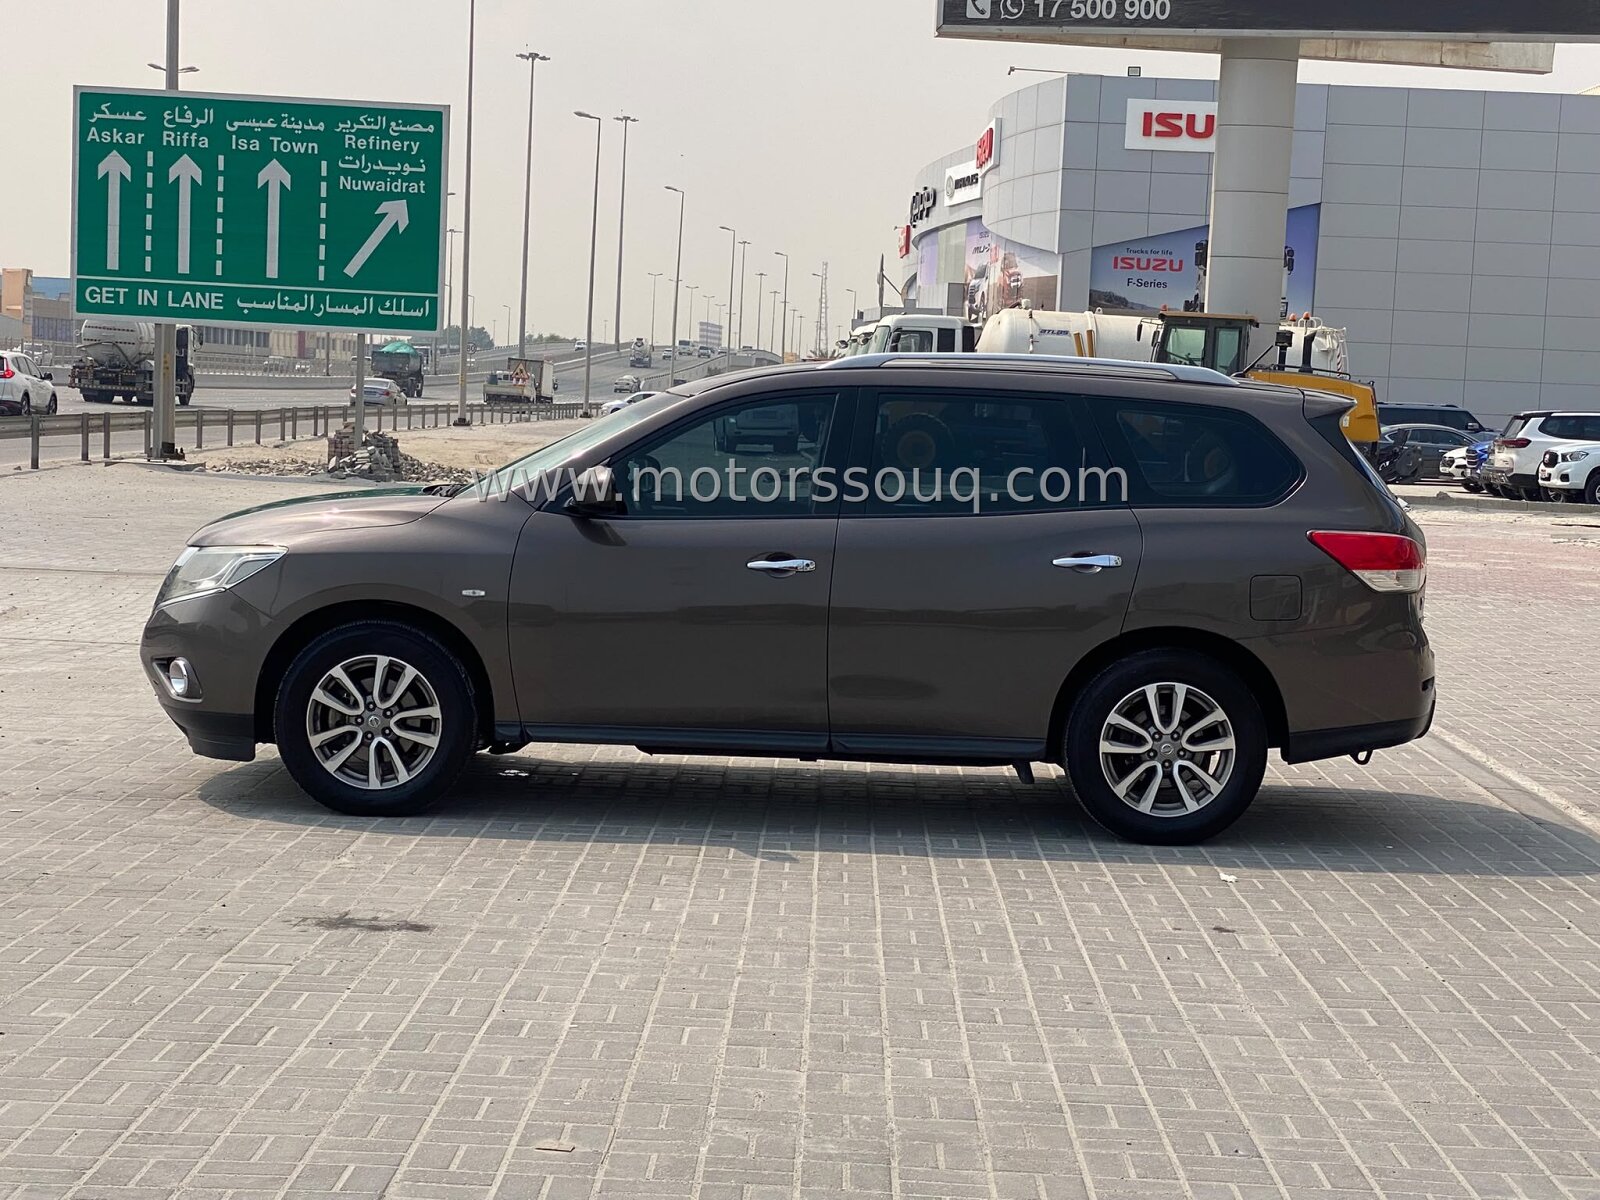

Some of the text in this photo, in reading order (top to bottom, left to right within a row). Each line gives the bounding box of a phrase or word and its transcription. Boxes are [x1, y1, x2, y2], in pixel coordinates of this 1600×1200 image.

[1034, 0, 1171, 20] 17 500 900
[88, 102, 147, 123] عسكر
[163, 105, 214, 128] الرفاع
[225, 113, 325, 135] مدينة عيسى
[334, 114, 435, 136] مصنع التكرير
[86, 126, 145, 145] Askar
[162, 130, 209, 148] Riffa
[231, 134, 319, 155] Isa Town
[344, 134, 420, 155] Refinery
[338, 154, 426, 175] نويدرات
[339, 175, 426, 194] Nuwaidrat
[1126, 247, 1149, 255] Trucks
[1113, 256, 1184, 272] ISUZU
[1127, 277, 1168, 289] F-Series
[84, 286, 224, 310] GET IN LANE
[236, 291, 430, 318] اسلك المسار المناسب
